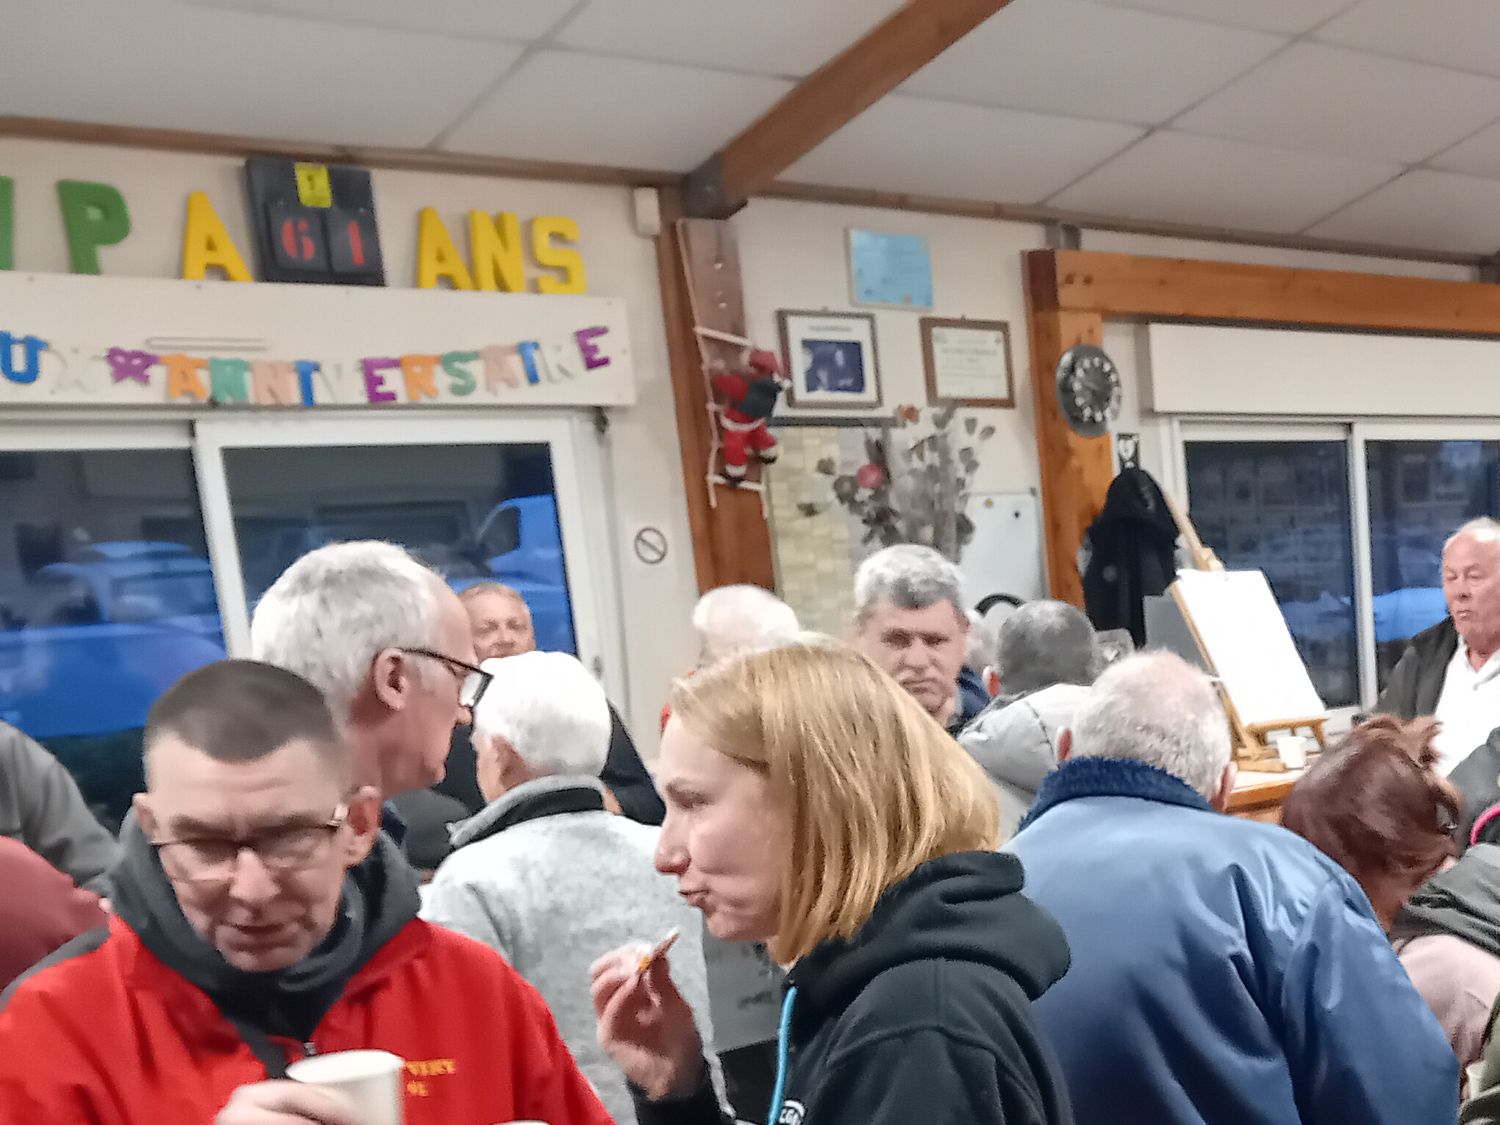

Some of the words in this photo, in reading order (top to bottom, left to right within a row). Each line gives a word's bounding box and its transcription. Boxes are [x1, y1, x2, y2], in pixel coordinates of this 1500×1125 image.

[281, 218, 366, 266] 61
[417, 206, 587, 295] ANS
[158, 326, 611, 407] ANNIVERSAIRE
